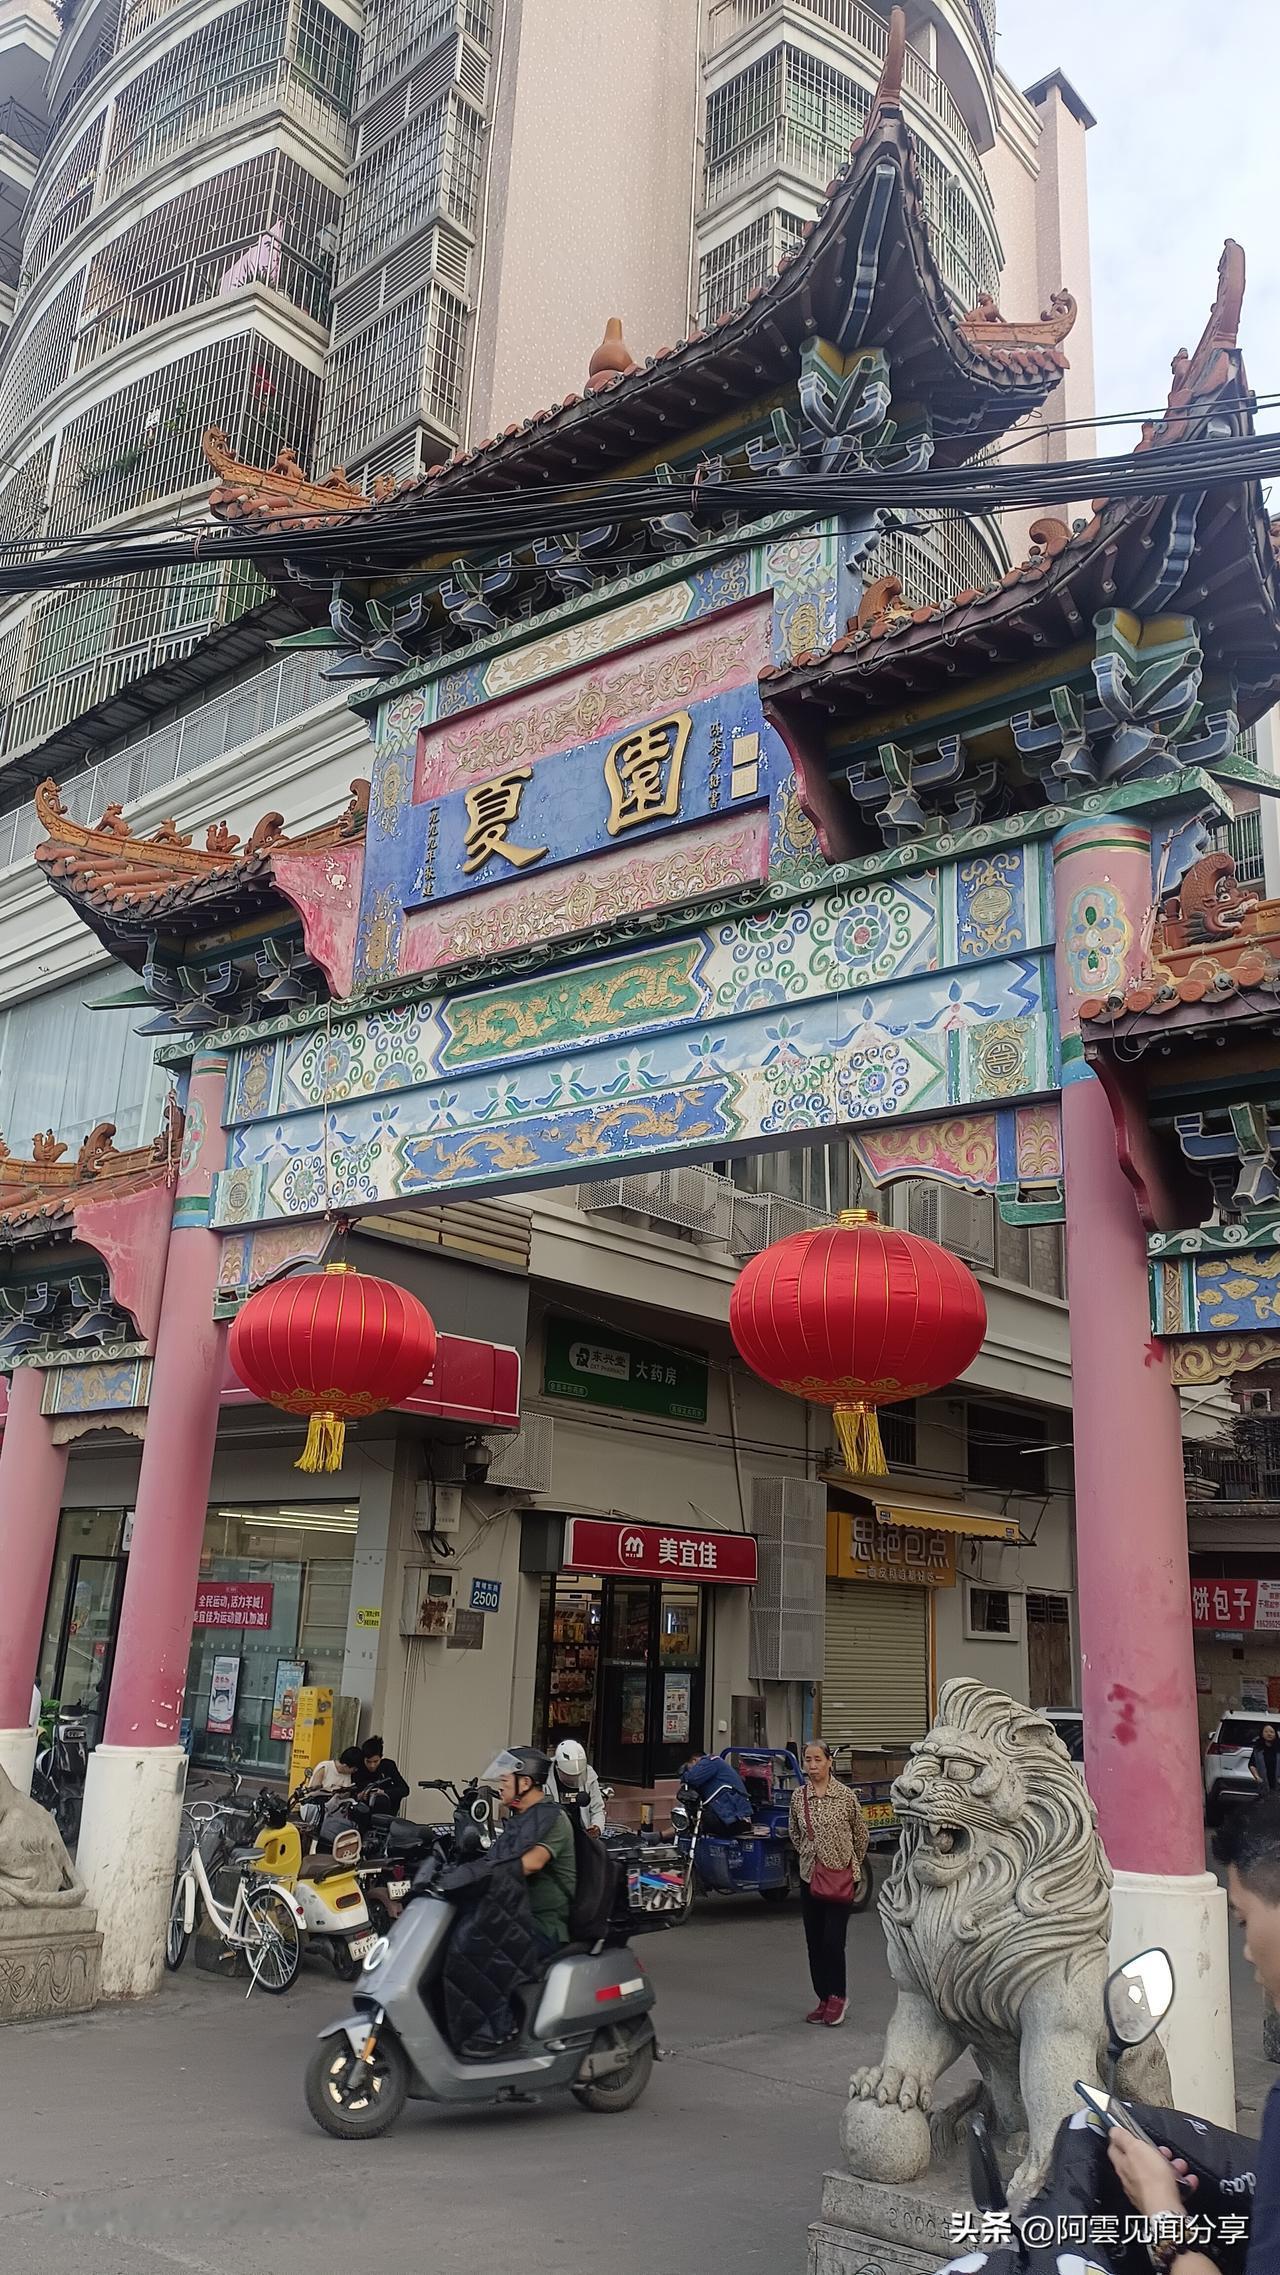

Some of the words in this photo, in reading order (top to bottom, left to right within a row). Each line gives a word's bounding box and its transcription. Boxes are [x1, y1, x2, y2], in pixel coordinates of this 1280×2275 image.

[635, 1361, 678, 1386] 大药房
[658, 1537, 718, 1569] 美宜佳
[472, 1590, 498, 1608] 2500
[1193, 1586, 1252, 1622] 饼包子
